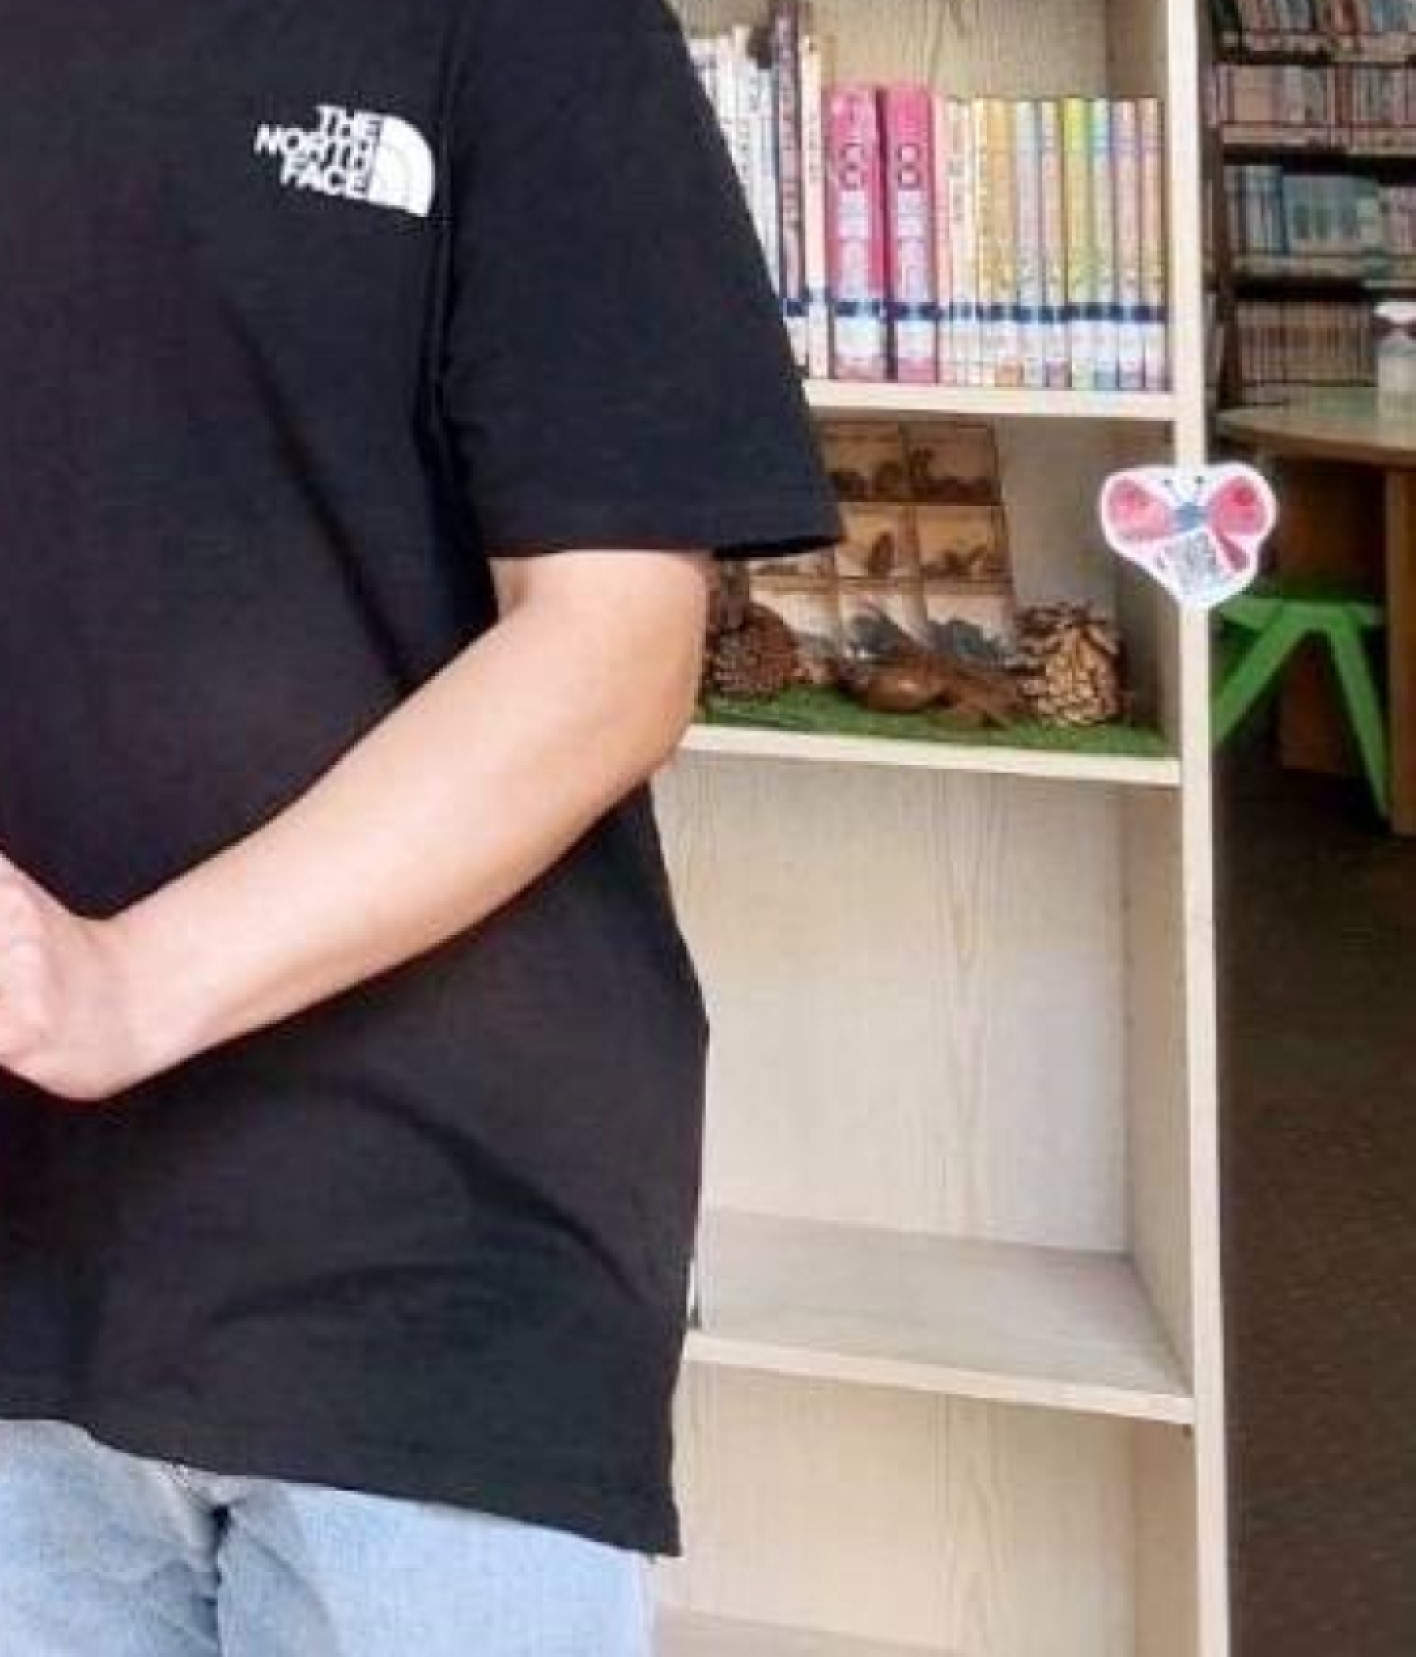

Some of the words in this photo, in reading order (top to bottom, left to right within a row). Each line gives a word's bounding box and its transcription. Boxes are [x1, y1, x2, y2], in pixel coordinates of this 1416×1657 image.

[315, 104, 383, 141] THE
[253, 123, 374, 171] NORTH
[279, 152, 371, 200] FACE
